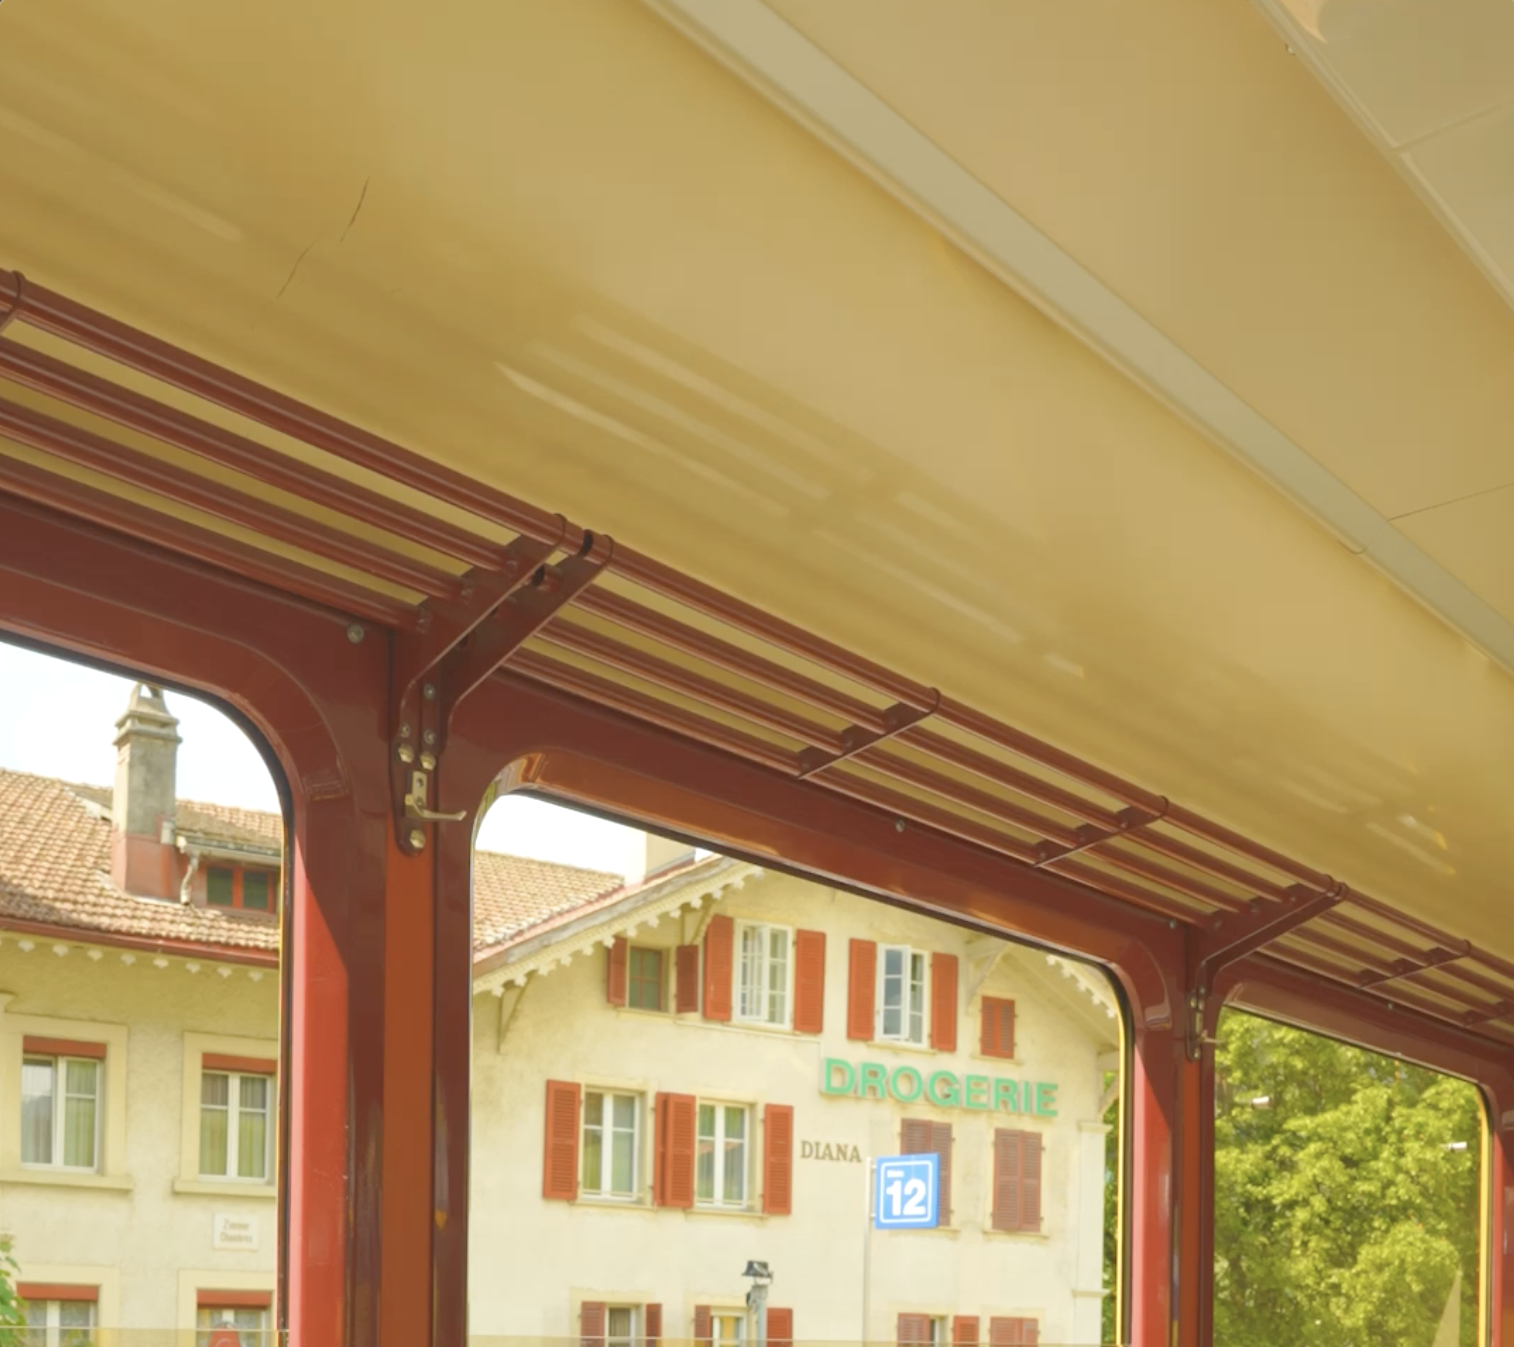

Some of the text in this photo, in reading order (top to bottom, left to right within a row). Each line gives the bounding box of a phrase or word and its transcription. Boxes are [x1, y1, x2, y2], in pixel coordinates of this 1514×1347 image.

[822, 1057, 1058, 1117] DROGERIE
[801, 1140, 862, 1163] DIANA
[886, 1178, 926, 1216] 12
